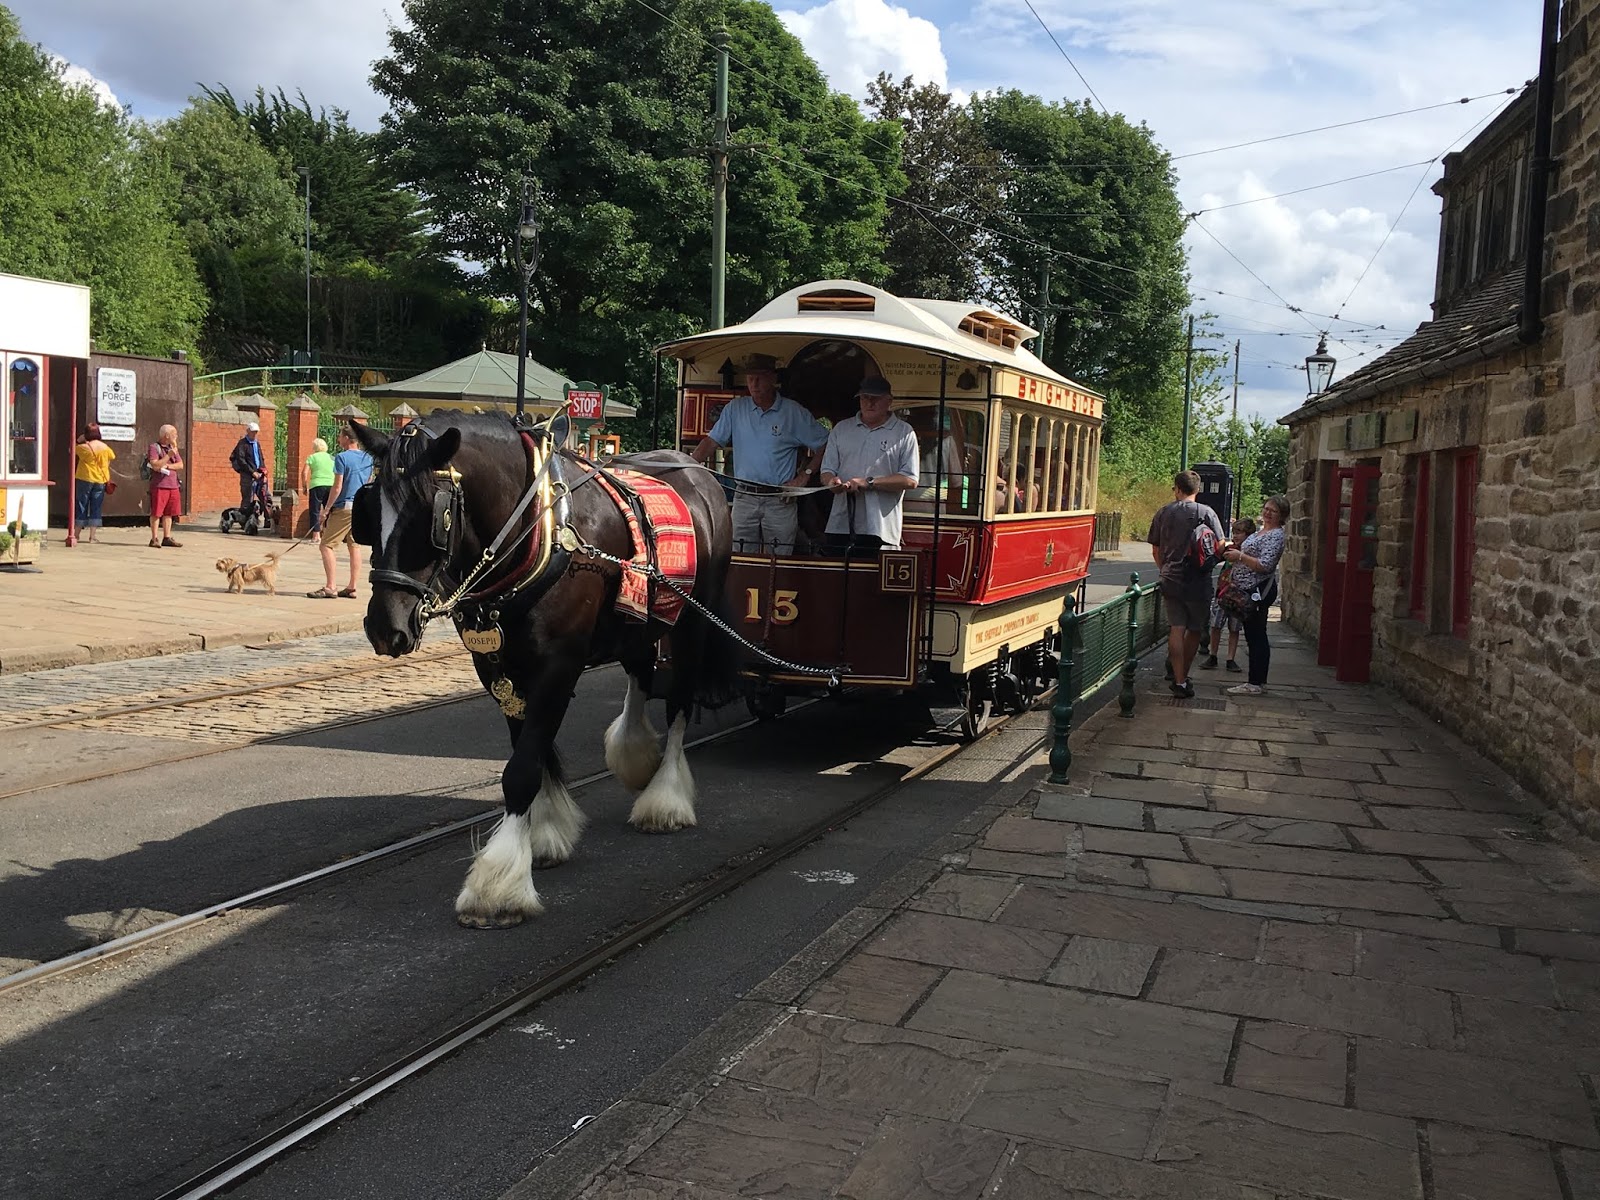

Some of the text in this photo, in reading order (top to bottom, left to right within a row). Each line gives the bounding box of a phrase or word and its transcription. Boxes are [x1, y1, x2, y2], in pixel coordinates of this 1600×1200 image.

[102, 391, 131, 403] FORGE
[1018, 376, 1095, 417] BRIGHTSIDE
[573, 397, 597, 414] STOP
[889, 564, 910, 581] 15
[744, 588, 799, 625] 15
[468, 637, 497, 645] JOSEPH
[975, 631, 984, 644] THE
[984, 624, 1003, 642] SHEFFIELD
